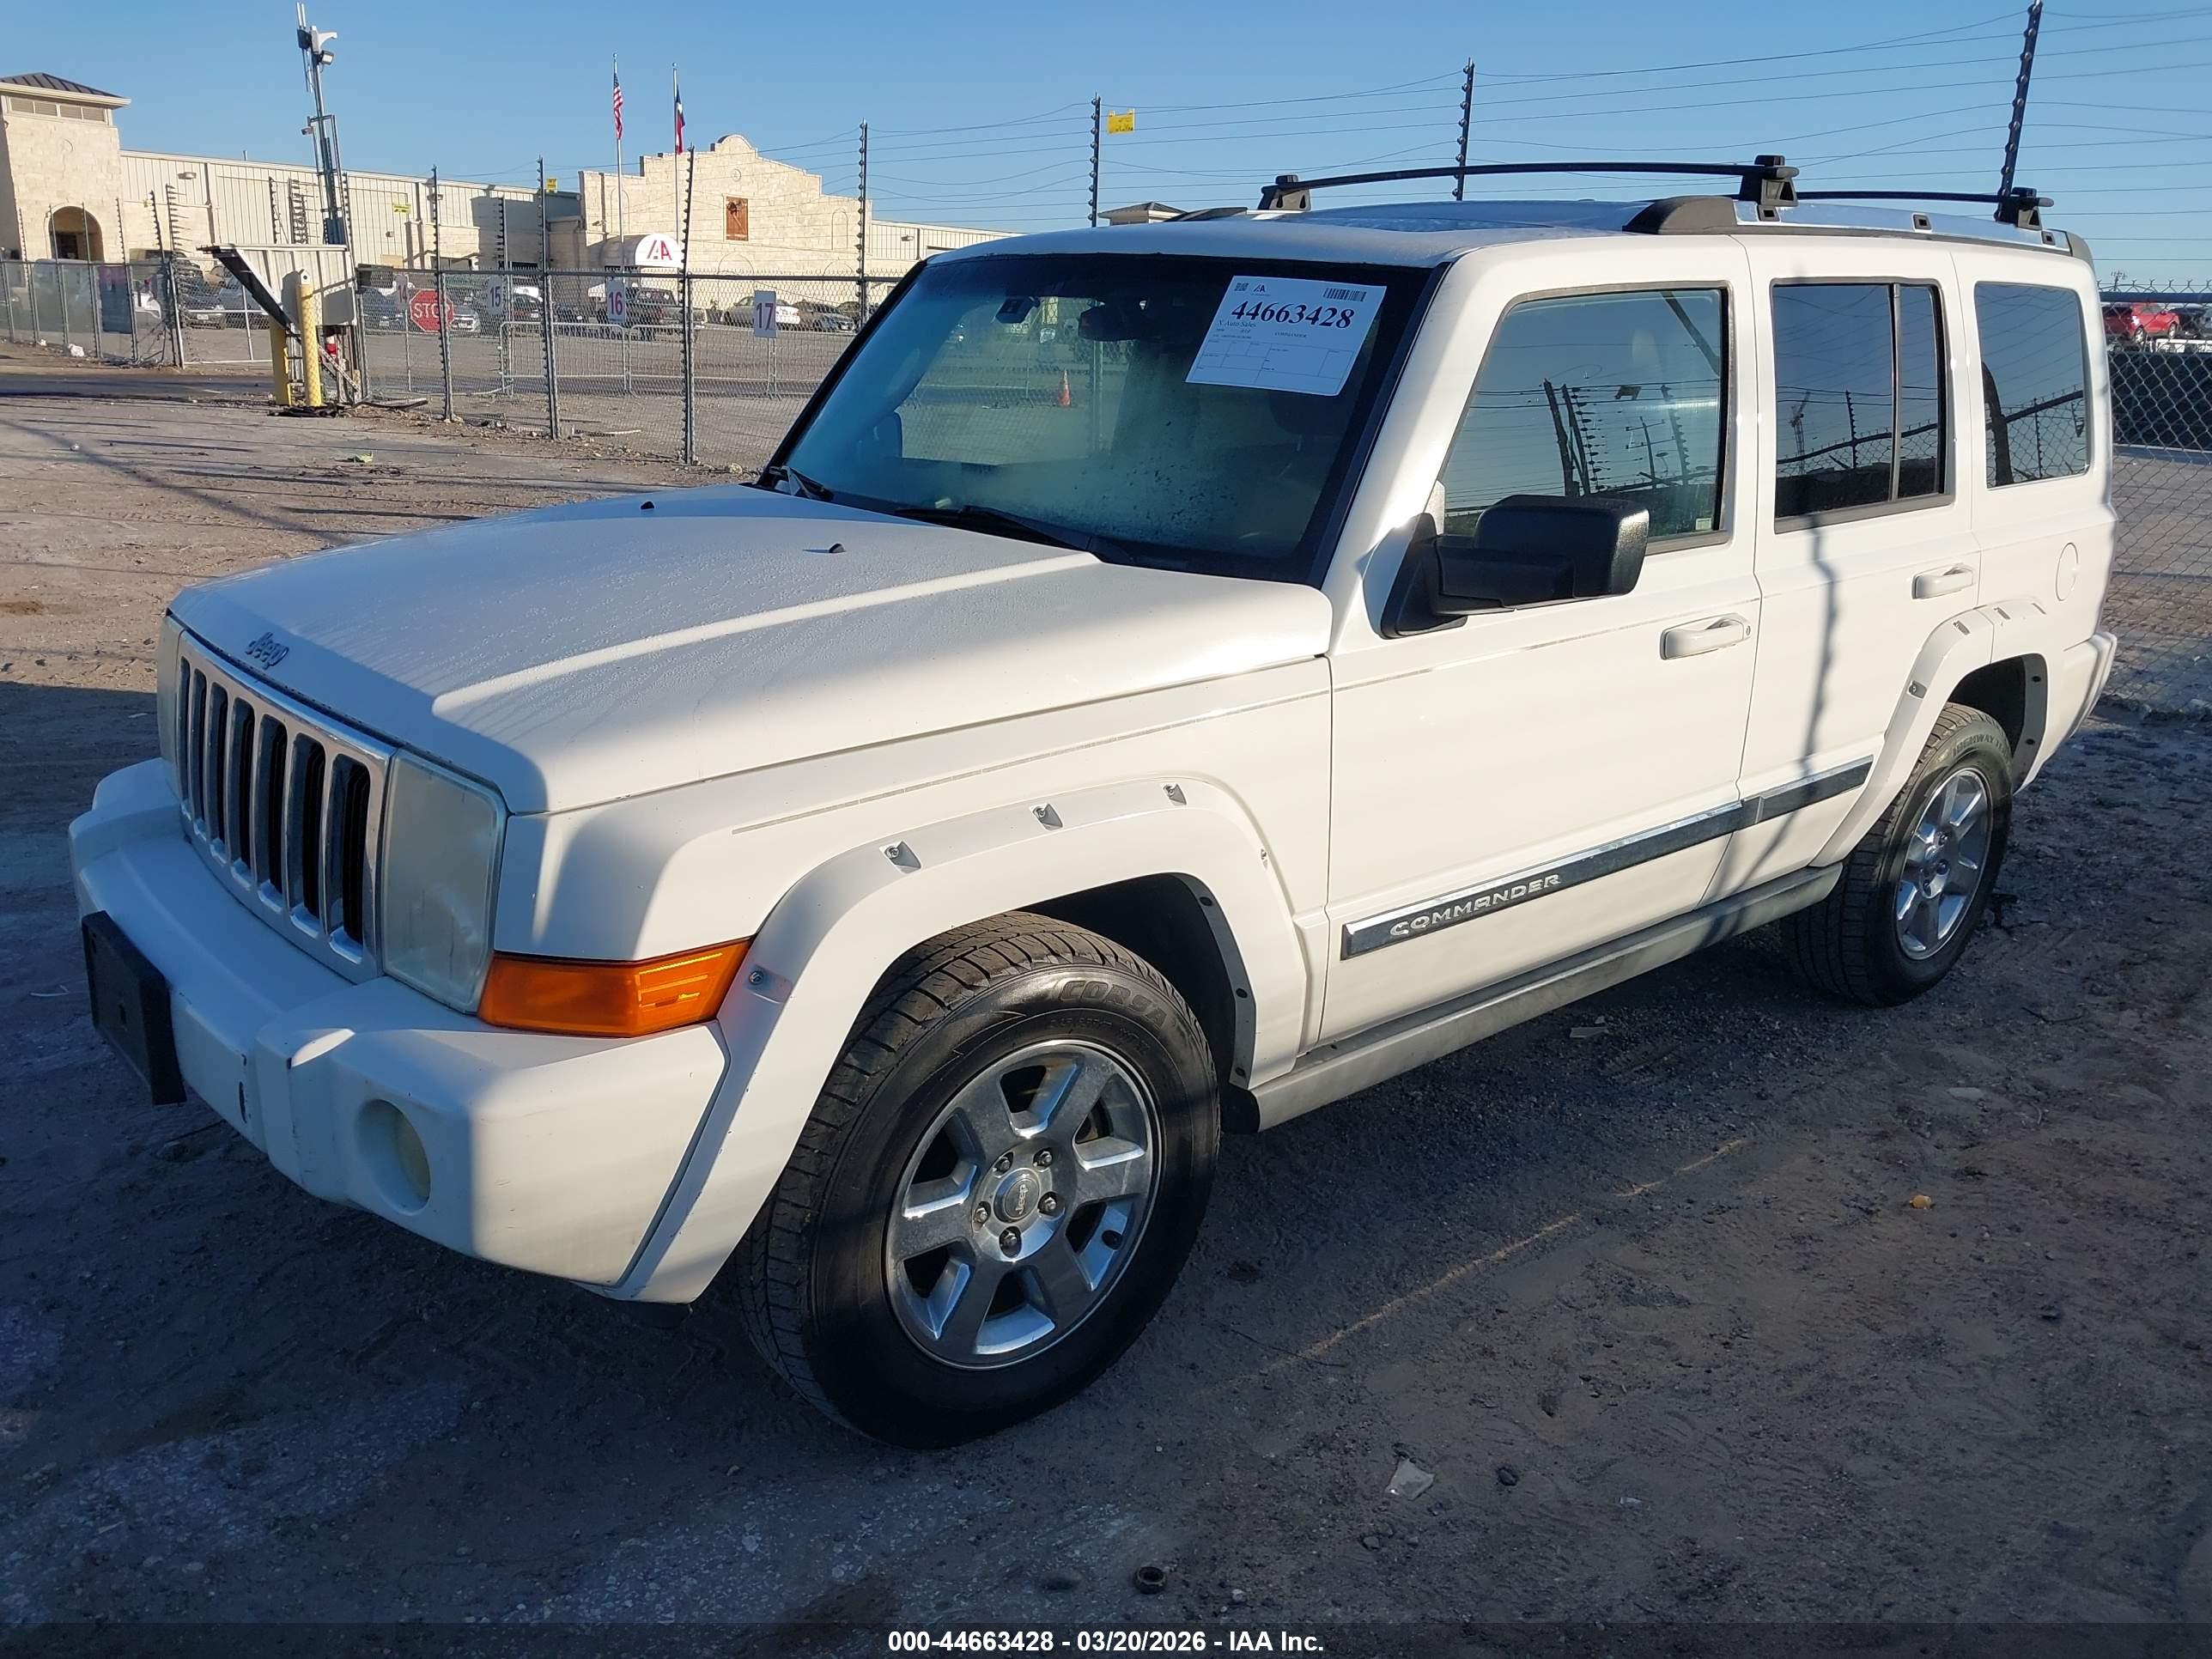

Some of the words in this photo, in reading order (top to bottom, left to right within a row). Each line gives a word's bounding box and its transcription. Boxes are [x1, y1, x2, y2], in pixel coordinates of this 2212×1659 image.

[398, 284, 409, 303] 14
[489, 286, 502, 307] 15
[608, 291, 623, 316] 16
[757, 302, 774, 331] 17
[1231, 301, 1355, 329] 44663428
[244, 631, 289, 670] Jeep
[1389, 873, 1560, 937] COMMANDER
[1060, 980, 1168, 1030] CORSA
